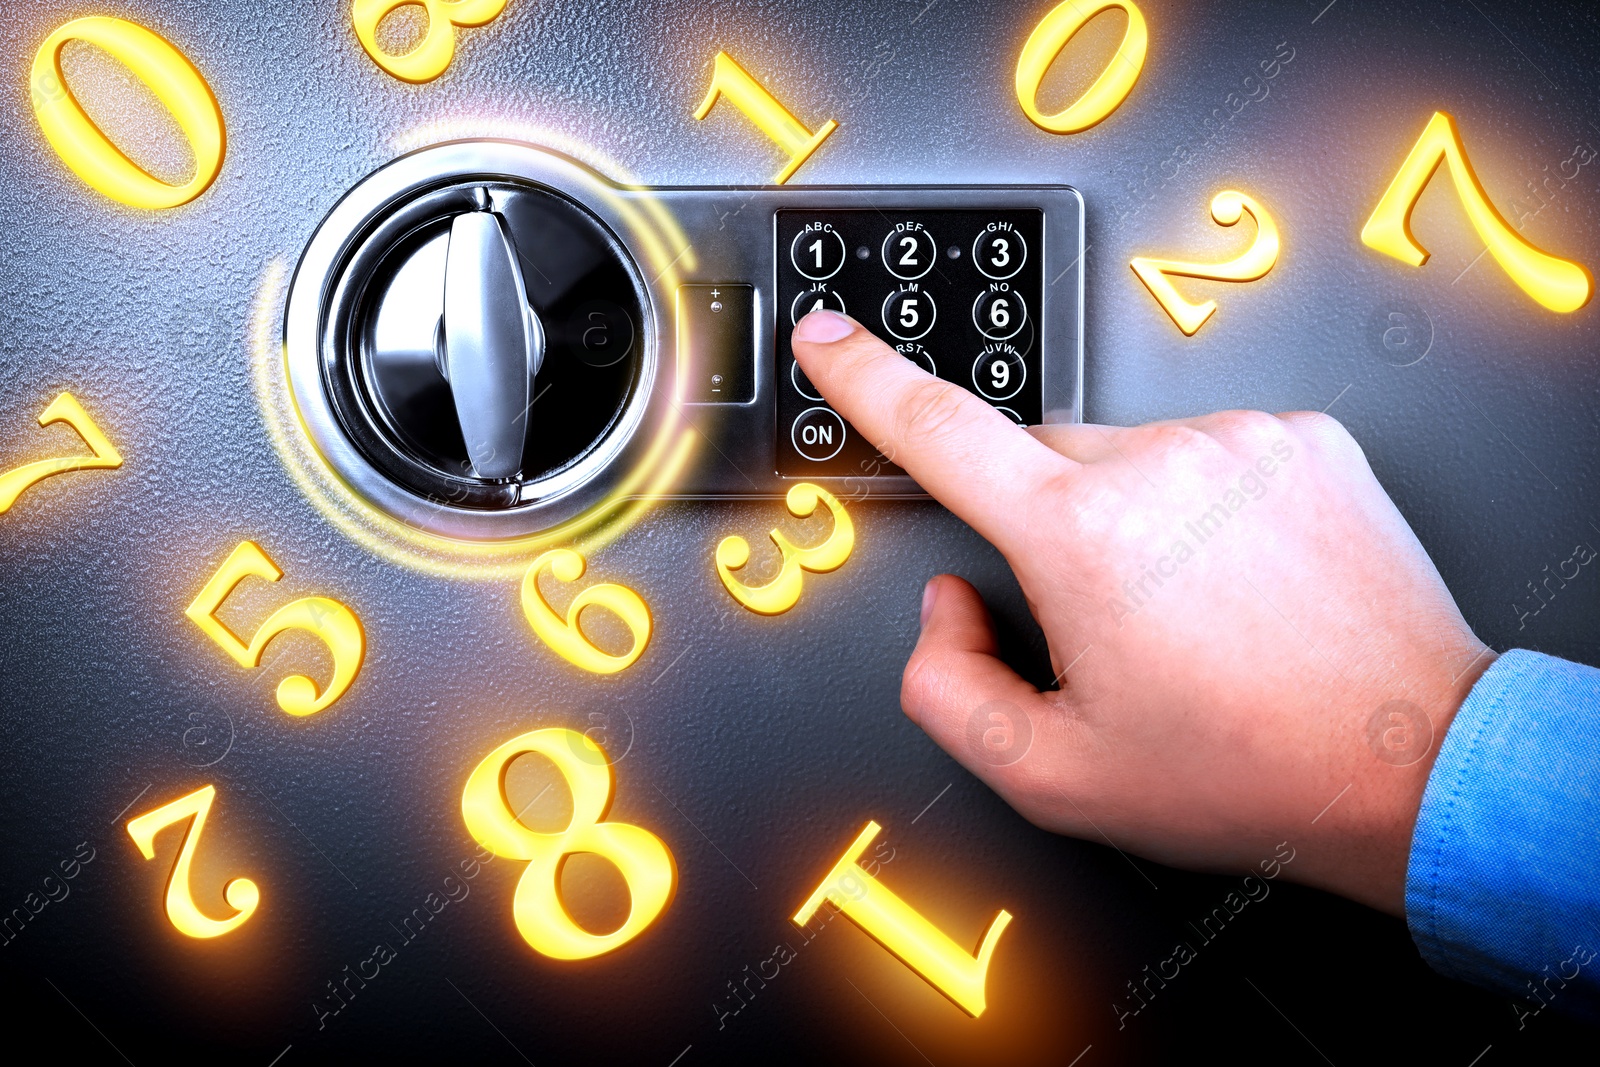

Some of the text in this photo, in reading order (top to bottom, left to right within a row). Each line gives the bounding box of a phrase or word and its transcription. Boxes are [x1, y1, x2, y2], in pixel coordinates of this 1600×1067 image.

[805, 221, 833, 233] ABC
[896, 221, 924, 233] DEF
[986, 221, 1013, 233] GHI
[808, 239, 823, 268] 1
[898, 237, 919, 266] 2
[990, 238, 1010, 267] 3
[810, 282, 828, 293] JK
[900, 282, 919, 293] LM
[990, 282, 1009, 293] NO
[899, 299, 919, 328] 5
[990, 298, 1010, 327] 6
[895, 342, 924, 354] RST
[985, 343, 1015, 355] UVW
[990, 360, 1010, 388] 9
[802, 425, 833, 445] ON
